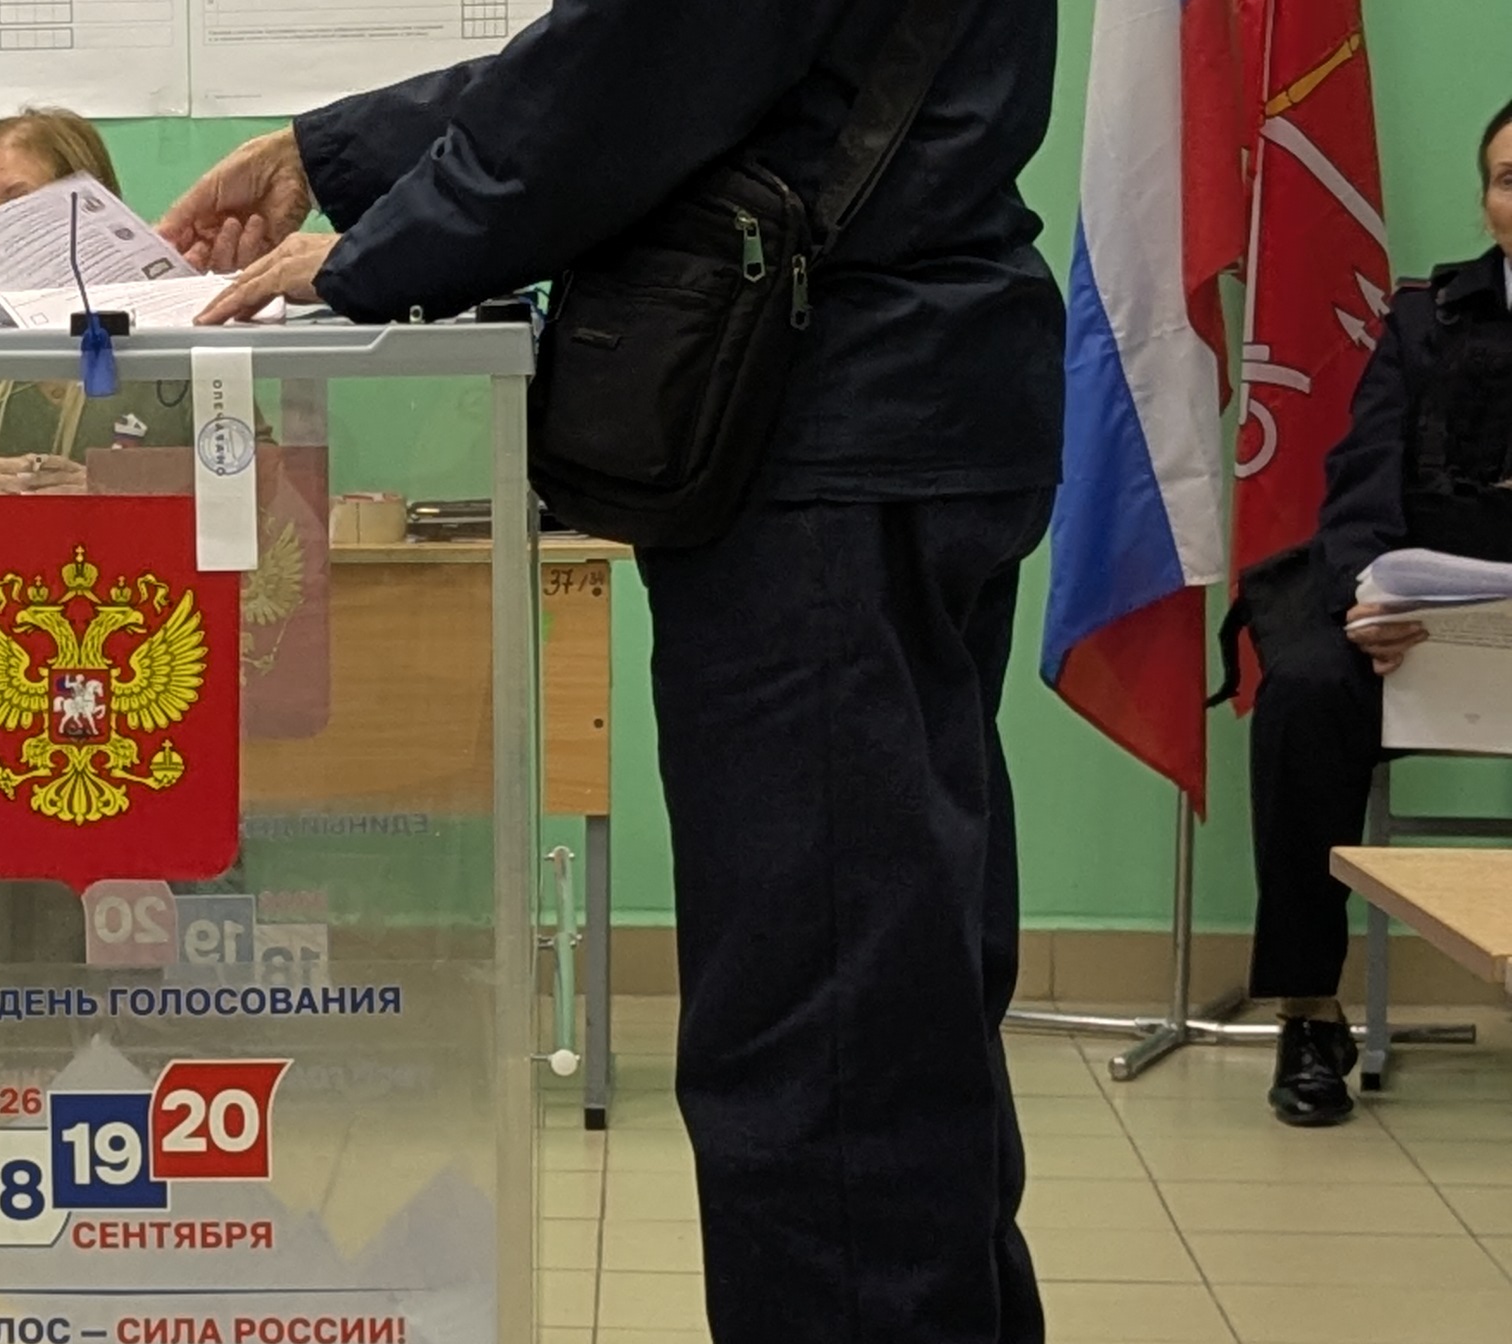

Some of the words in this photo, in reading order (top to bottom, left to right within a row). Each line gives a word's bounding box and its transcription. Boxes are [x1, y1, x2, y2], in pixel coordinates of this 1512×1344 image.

[109, 987, 401, 1016] ГОЛОСОВАНИЯ
[161, 1089, 260, 1152] 20
[62, 1122, 143, 1185] 19
[72, 1221, 273, 1249] СЕНТЯБРЯ
